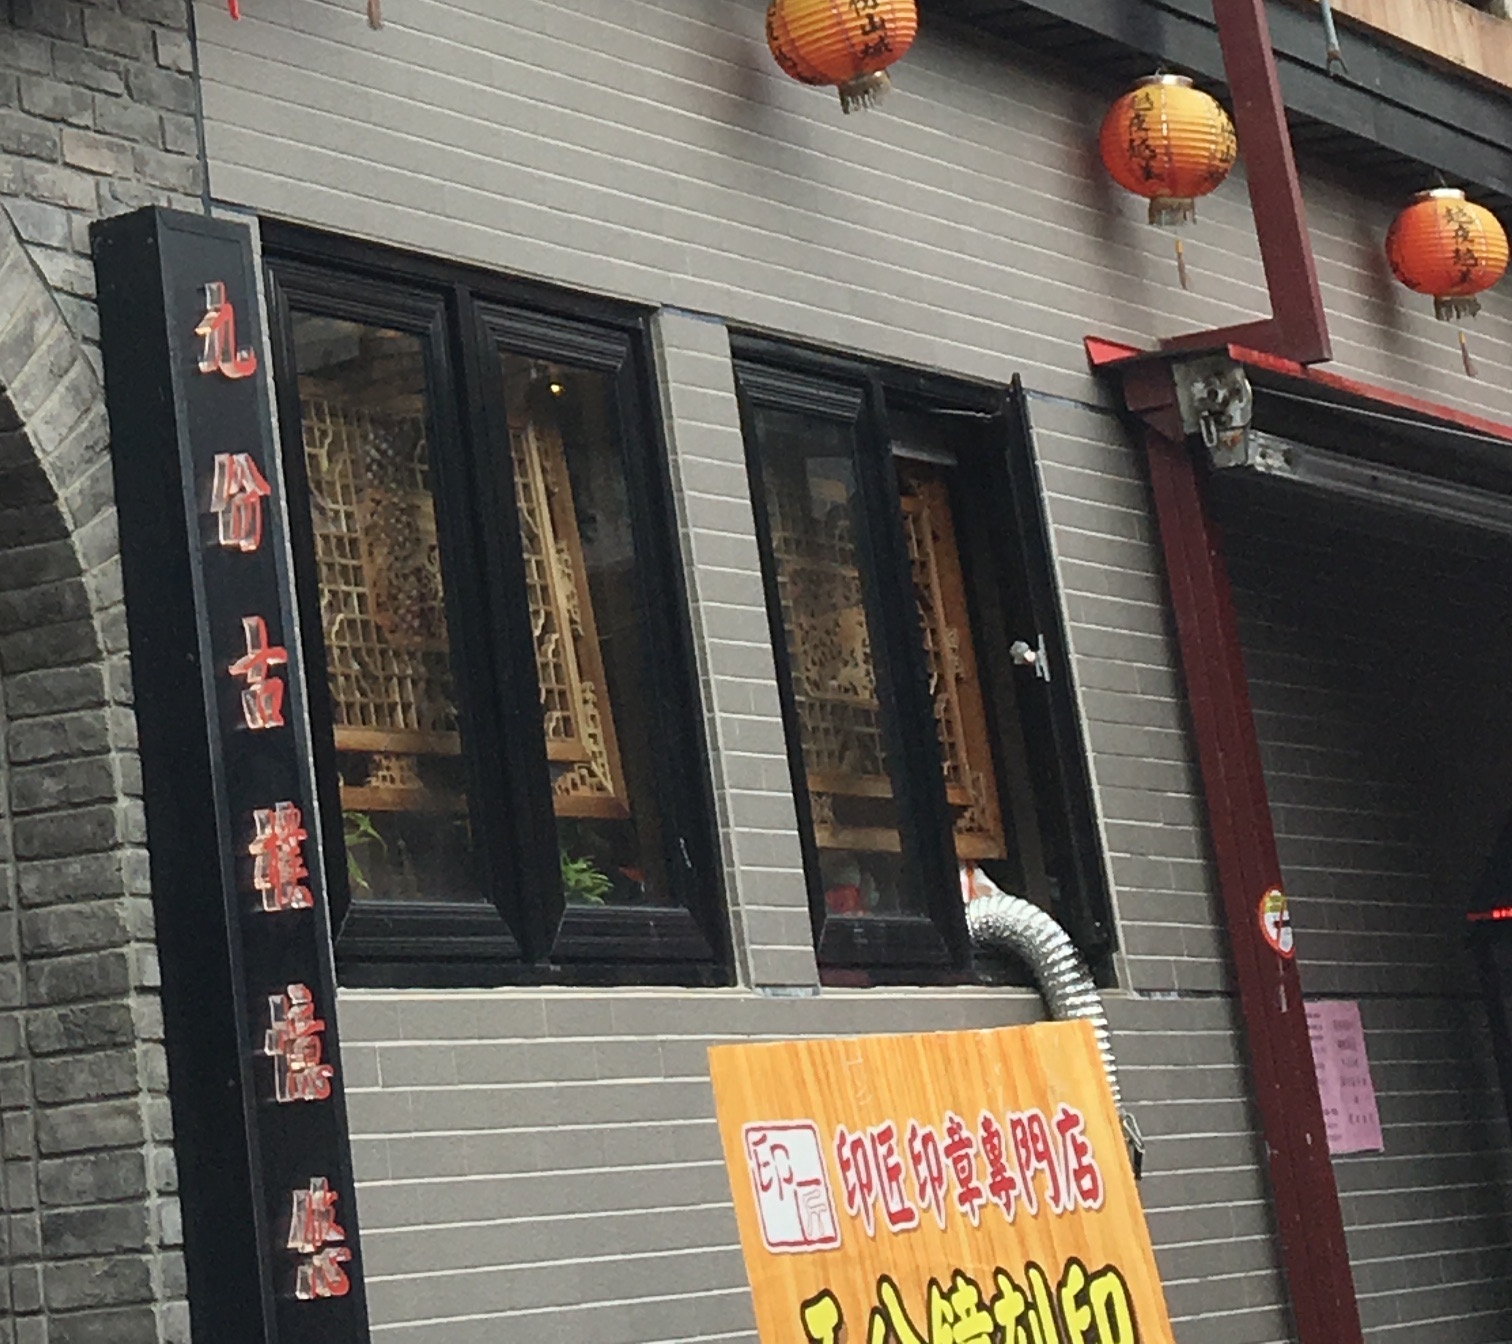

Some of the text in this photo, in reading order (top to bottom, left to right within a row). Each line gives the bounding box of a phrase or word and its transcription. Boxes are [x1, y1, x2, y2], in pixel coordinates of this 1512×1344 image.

[836, 1107, 1102, 1233] 印匠印章專門店
